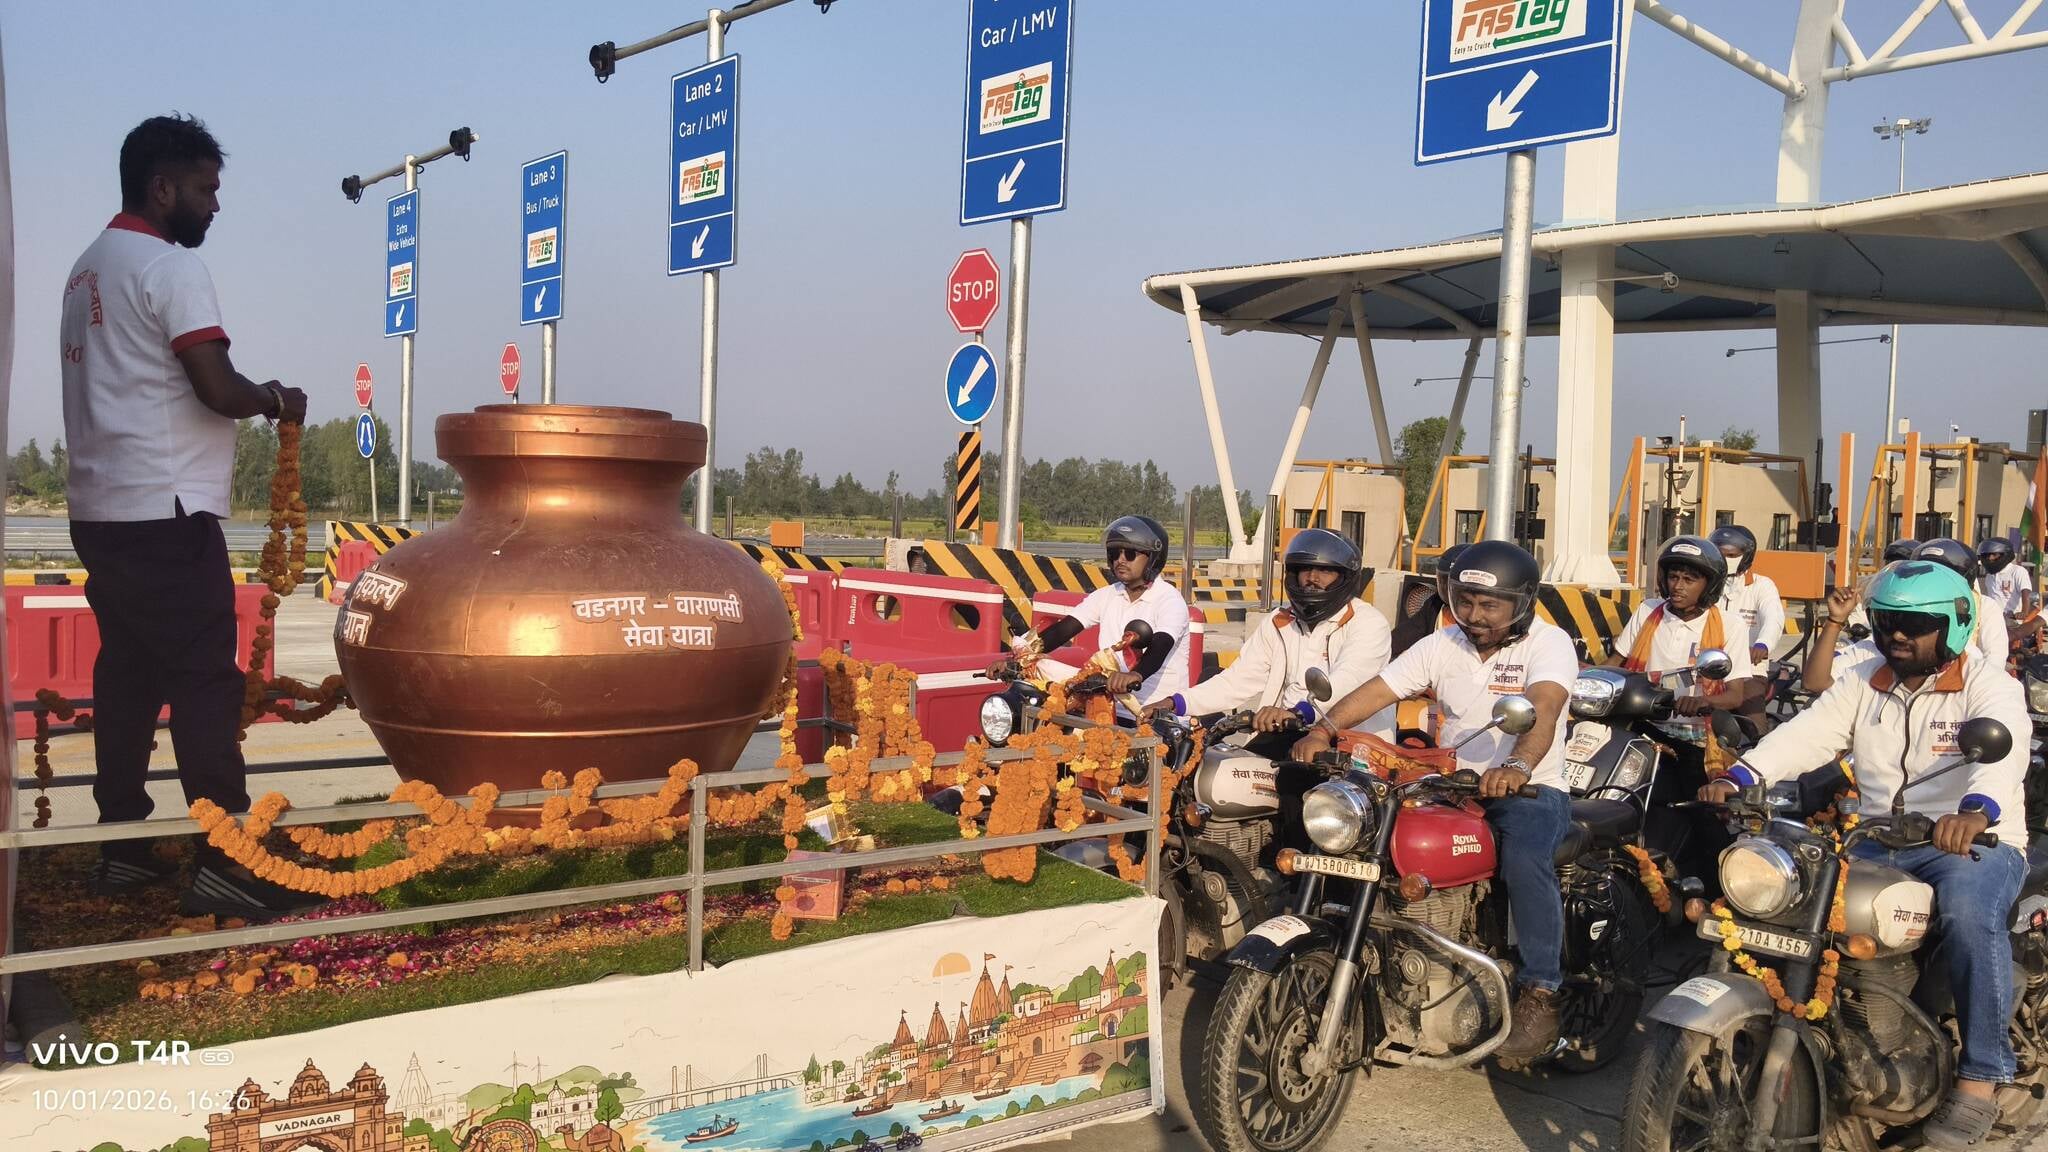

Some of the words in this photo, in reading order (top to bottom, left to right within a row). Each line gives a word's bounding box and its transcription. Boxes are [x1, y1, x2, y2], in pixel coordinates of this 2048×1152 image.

[981, 27, 1007, 48] Car
[1009, 18, 1017, 43] /
[1022, 6, 1057, 36] LMV
[1454, 46, 1466, 55] Easy
[1467, 44, 1473, 52] to
[1474, 42, 1491, 50] Cruise
[685, 82, 711, 103] Lane
[715, 73, 723, 94] 2
[679, 121, 696, 138] Car
[698, 116, 703, 135] /
[705, 108, 728, 131] LMV
[530, 171, 548, 187] Lane
[550, 165, 556, 180] 3
[393, 203, 406, 217] Lane
[406, 199, 412, 212] 4
[526, 202, 538, 215] Bus
[543, 194, 560, 210] Truck
[396, 224, 408, 236] Extra
[389, 240, 399, 252] Wide
[400, 234, 416, 249] Vehicle
[952, 279, 994, 303] STOP
[502, 362, 519, 376] STOP
[356, 379, 371, 391] STOP
[573, 596, 646, 618] वडनगर
[673, 593, 741, 618] वाराणसी
[621, 619, 665, 647] सेवा
[669, 625, 713, 646] यात्रा
[1930, 719, 1946, 730] सेवा
[1232, 768, 1250, 779] सेवा
[1452, 834, 1478, 845] ROYAL
[1452, 843, 1482, 856] ENFIELD
[1893, 904, 1911, 922] सेवा
[1776, 935, 1810, 956] 4567
[275, 1114, 341, 1132] VADNAGAR
